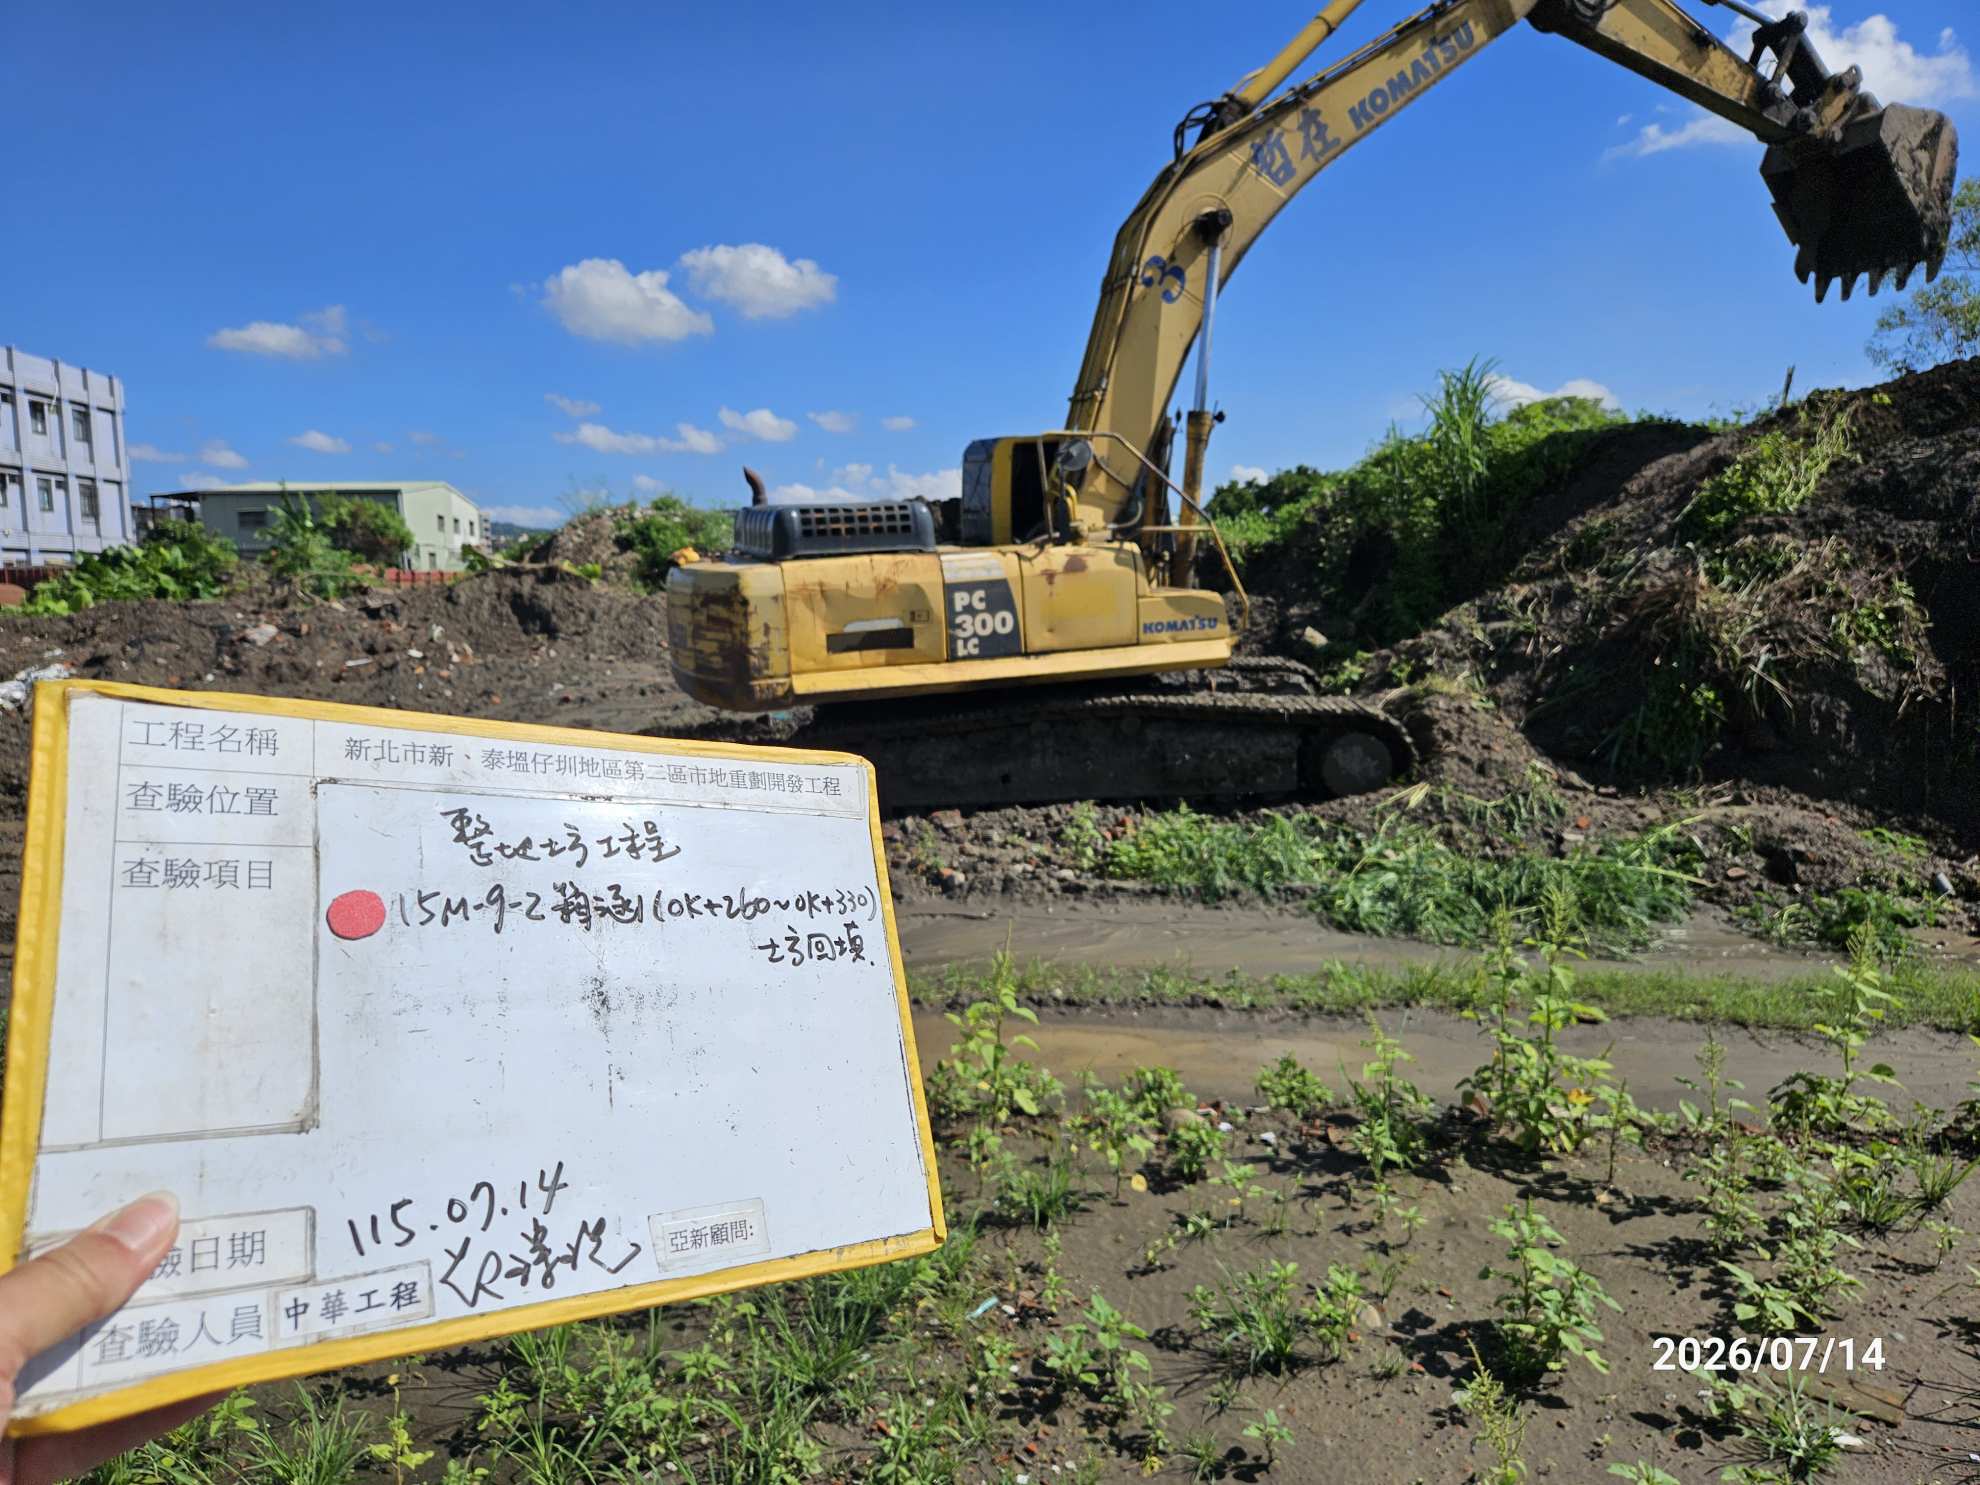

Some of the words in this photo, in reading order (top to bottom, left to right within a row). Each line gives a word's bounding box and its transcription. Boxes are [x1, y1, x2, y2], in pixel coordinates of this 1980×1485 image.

[1347, 20, 1475, 131] KOMATSU
[953, 590, 987, 612] PC
[954, 610, 1014, 638] 300
[1143, 614, 1218, 634] KOMATSU
[956, 637, 980, 656] LC
[128, 719, 279, 757] 工程名稱
[125, 781, 279, 816] 查驗位置
[121, 857, 274, 890] 查驗項目
[348, 1161, 568, 1256] 115.07.14
[148, 1229, 267, 1280] 日期
[284, 1280, 422, 1332] 中華工程
[90, 1304, 263, 1366] 查驗人員
